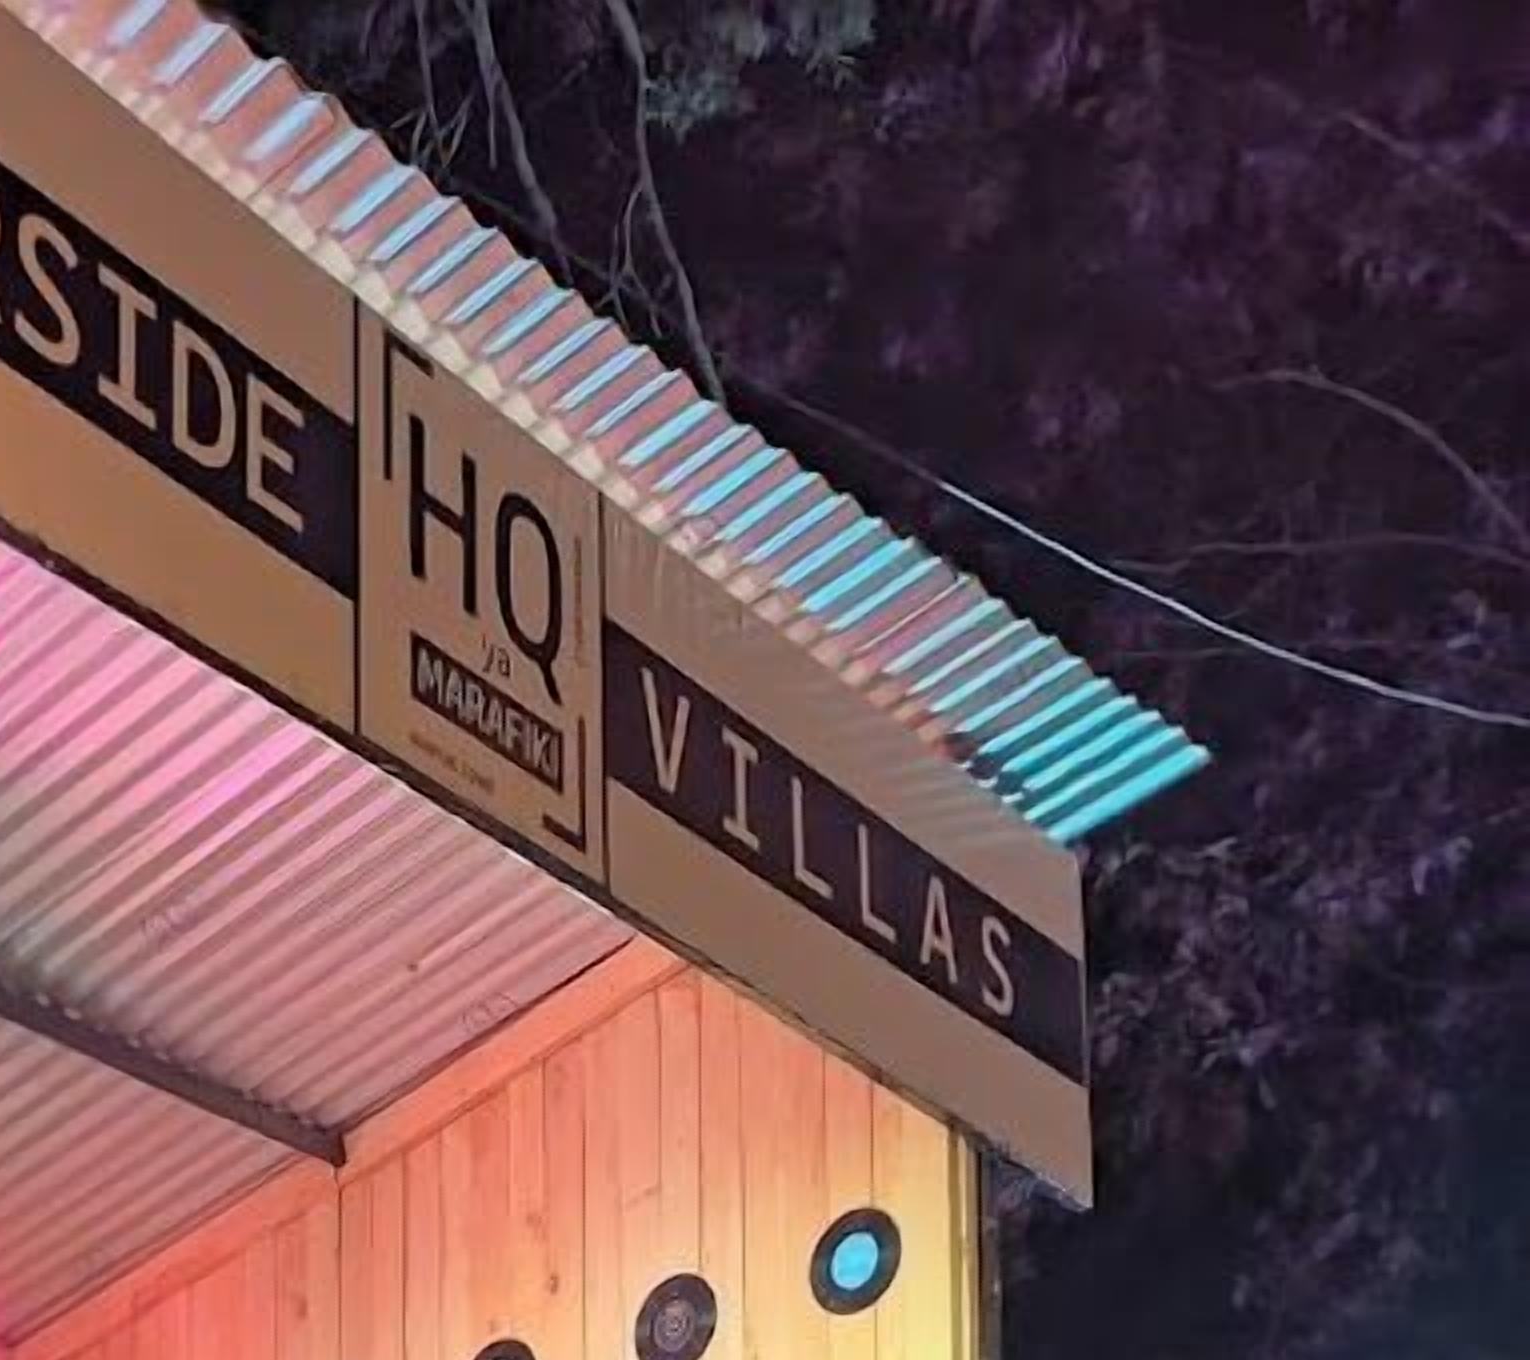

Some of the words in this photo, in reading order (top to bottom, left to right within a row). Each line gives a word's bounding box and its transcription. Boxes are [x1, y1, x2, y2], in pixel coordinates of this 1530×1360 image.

[409, 414, 562, 705] HQ
[416, 647, 559, 780] MARAFIKI
[641, 666, 1014, 1018] VILLAS
